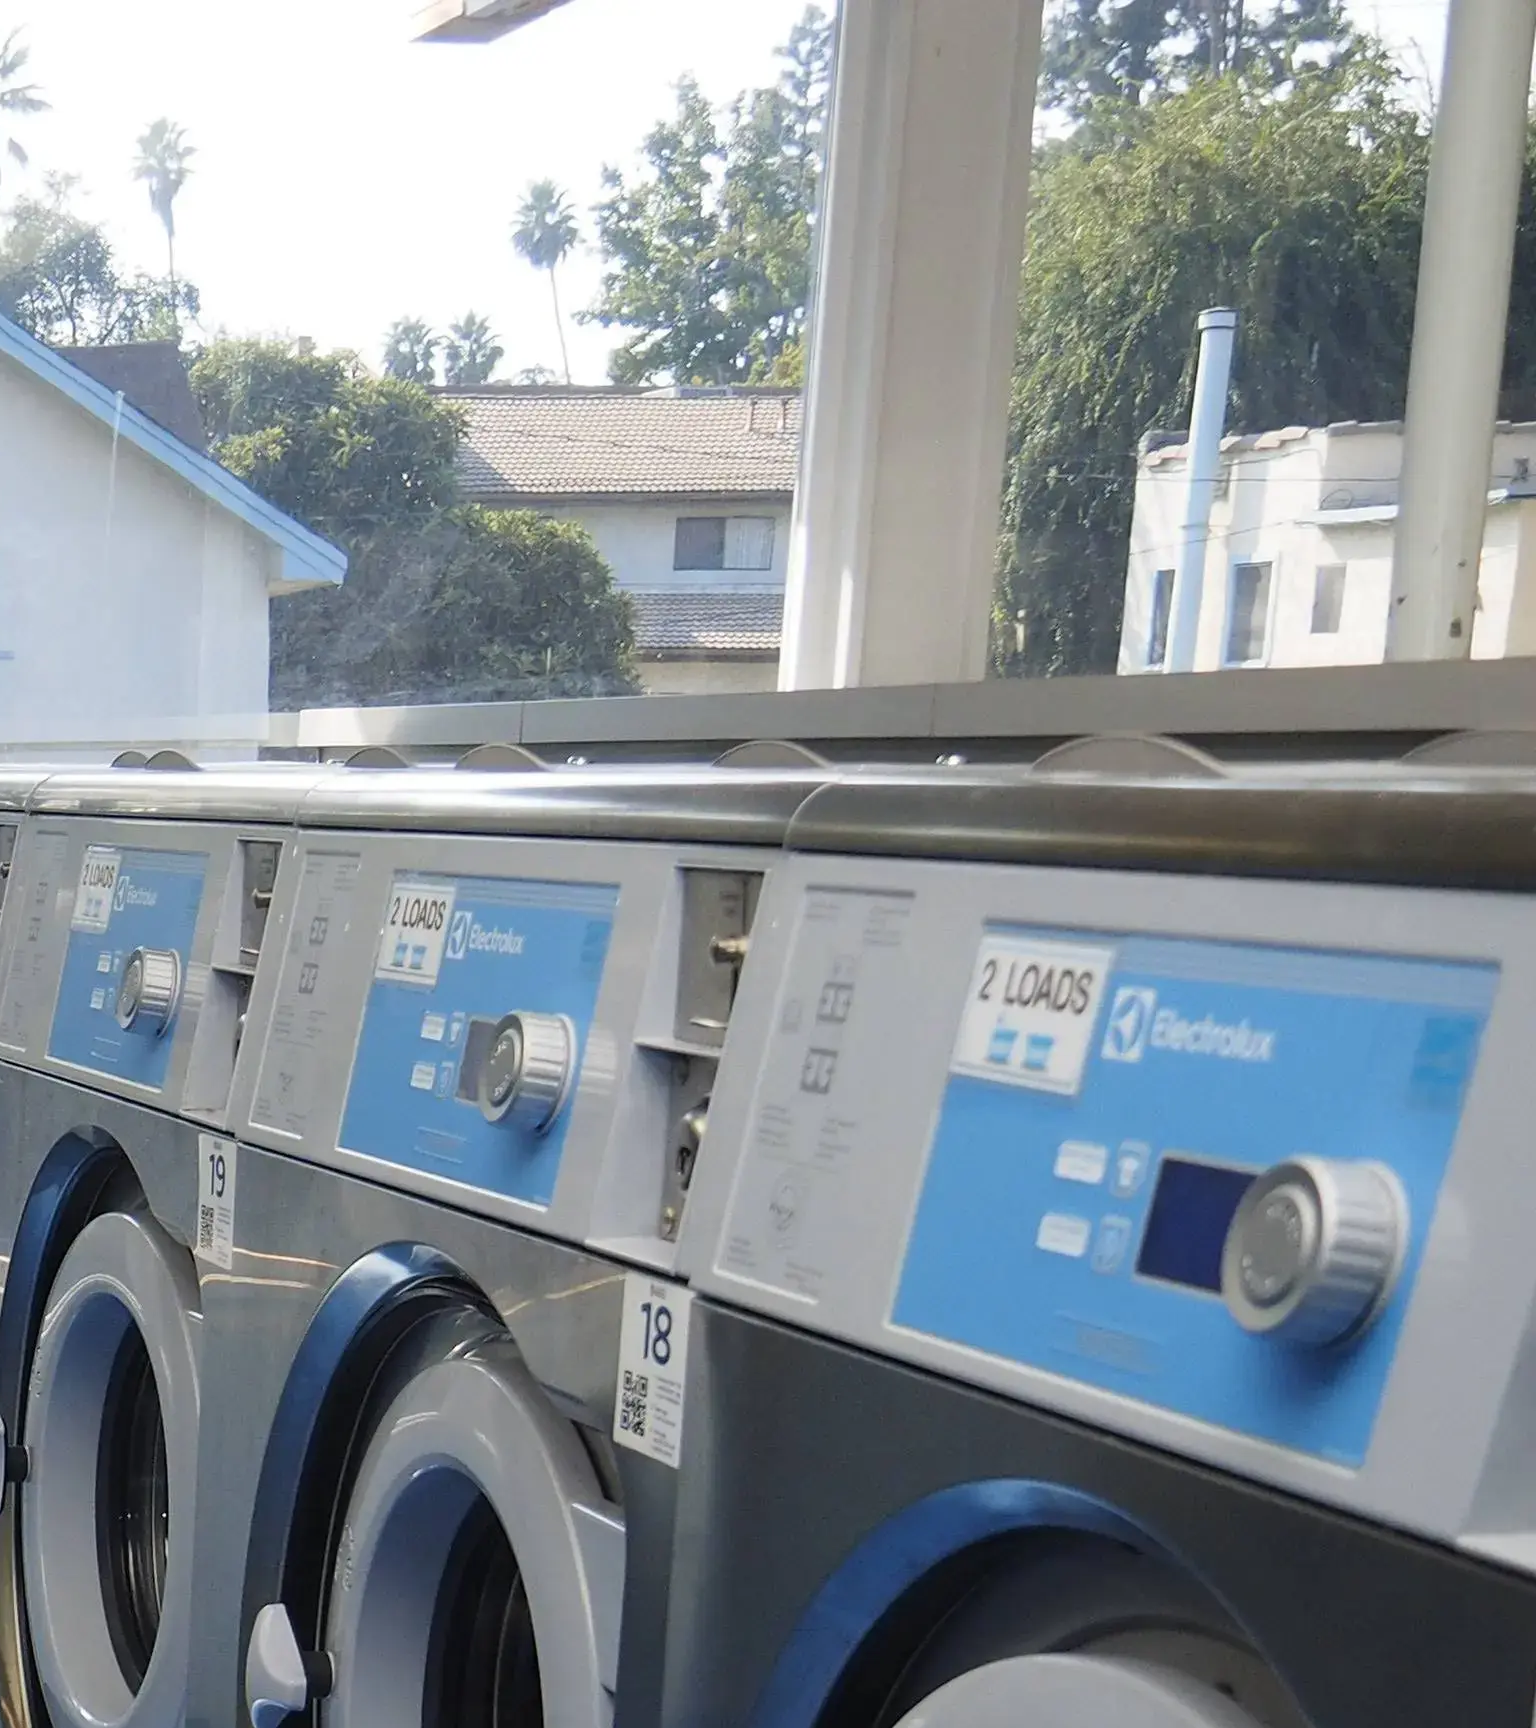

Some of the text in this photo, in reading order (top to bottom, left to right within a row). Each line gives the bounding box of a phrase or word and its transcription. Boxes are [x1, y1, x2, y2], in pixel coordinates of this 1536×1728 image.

[89, 863, 116, 889] LOADS
[389, 896, 447, 931] 2 LOADS
[468, 923, 526, 955] Electrolux
[979, 958, 1094, 1016] 2 LOADS
[1149, 1007, 1278, 1063] Electrolux
[208, 1152, 226, 1198] 19
[640, 1301, 673, 1367] 18
